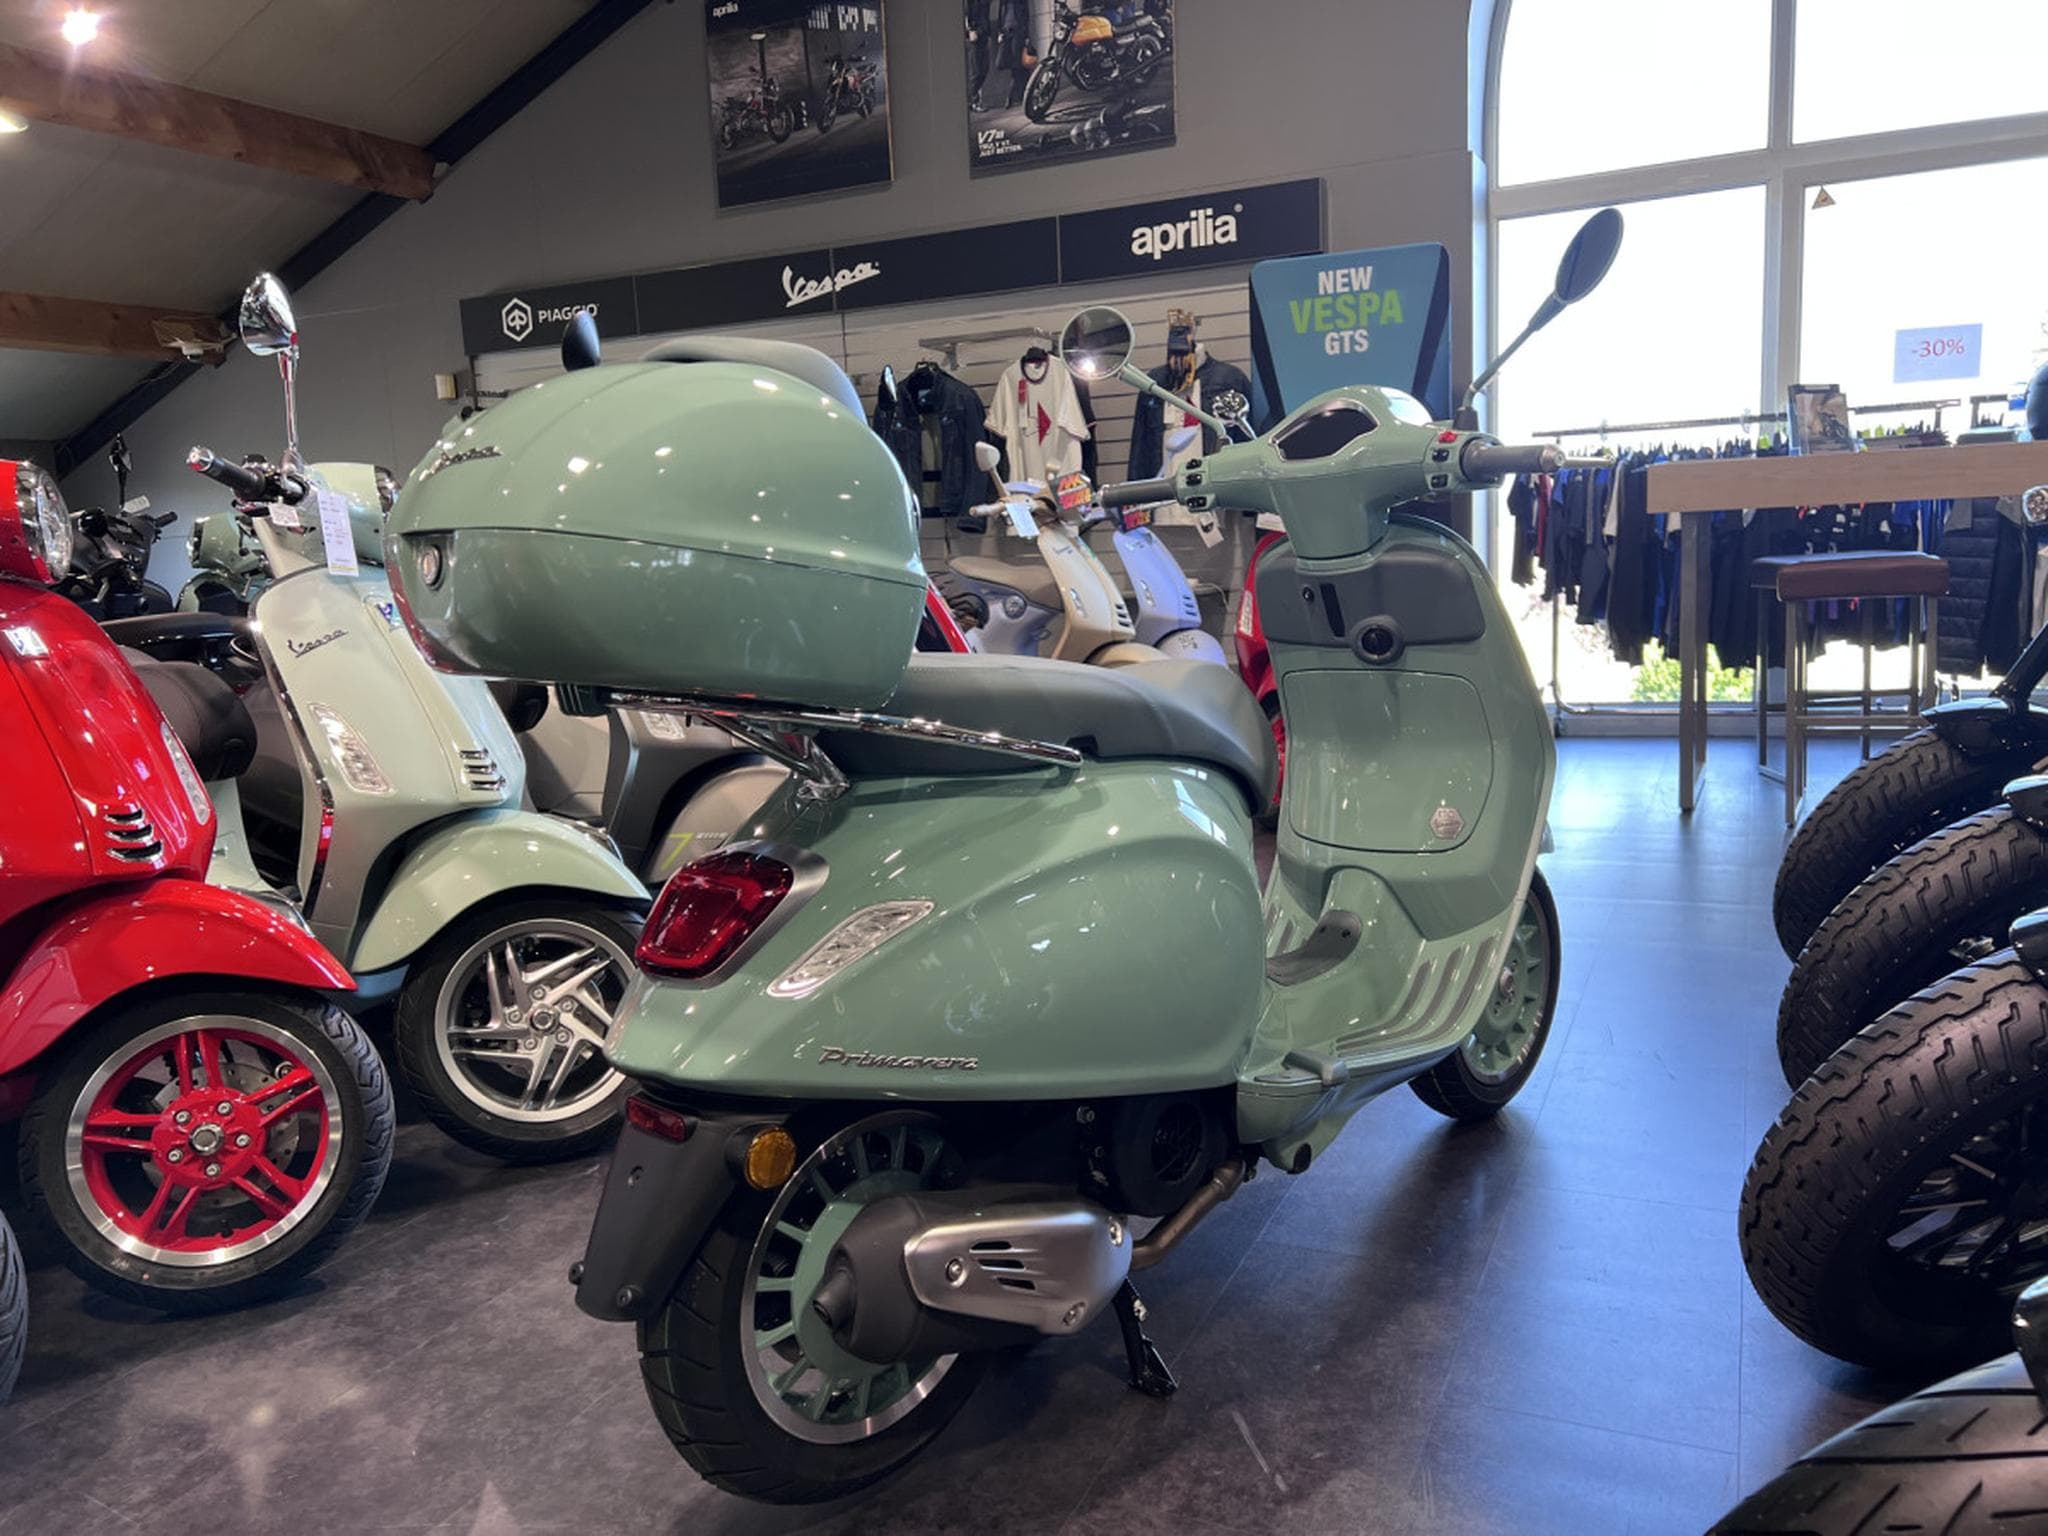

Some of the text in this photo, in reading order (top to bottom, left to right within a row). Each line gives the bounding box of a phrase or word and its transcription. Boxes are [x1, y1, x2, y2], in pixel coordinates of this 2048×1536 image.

[1131, 207, 1237, 260] aprilia
[782, 265, 881, 308] Vespa
[1318, 266, 1373, 295] NEW
[1289, 288, 1404, 335] VESPA
[1324, 328, 1369, 356] GTS
[1911, 336, 1965, 358] -30%
[287, 629, 349, 658] Vespa
[818, 1045, 979, 1071] Primavera
